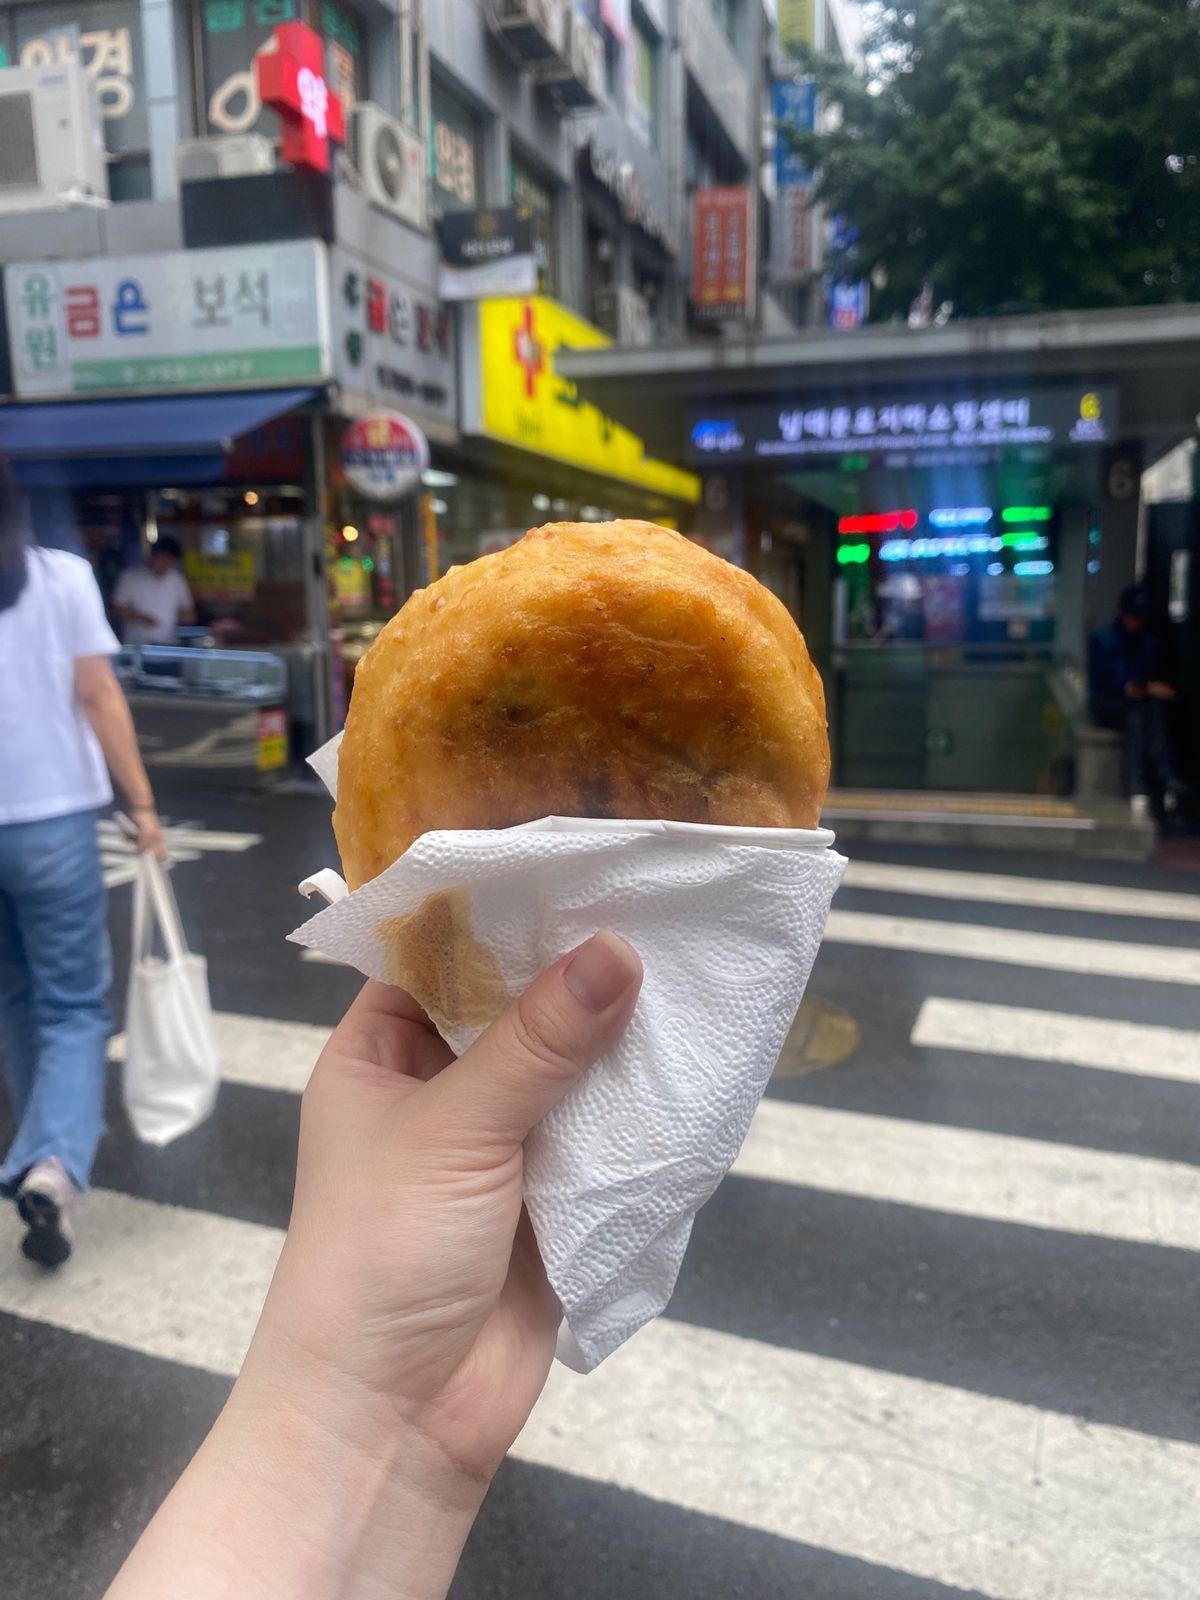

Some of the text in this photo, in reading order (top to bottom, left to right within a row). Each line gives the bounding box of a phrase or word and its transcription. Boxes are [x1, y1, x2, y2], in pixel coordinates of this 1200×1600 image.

[297, 66, 328, 137] 약
[64, 270, 270, 338] 금은 보석
[1080, 392, 1100, 422] 6
